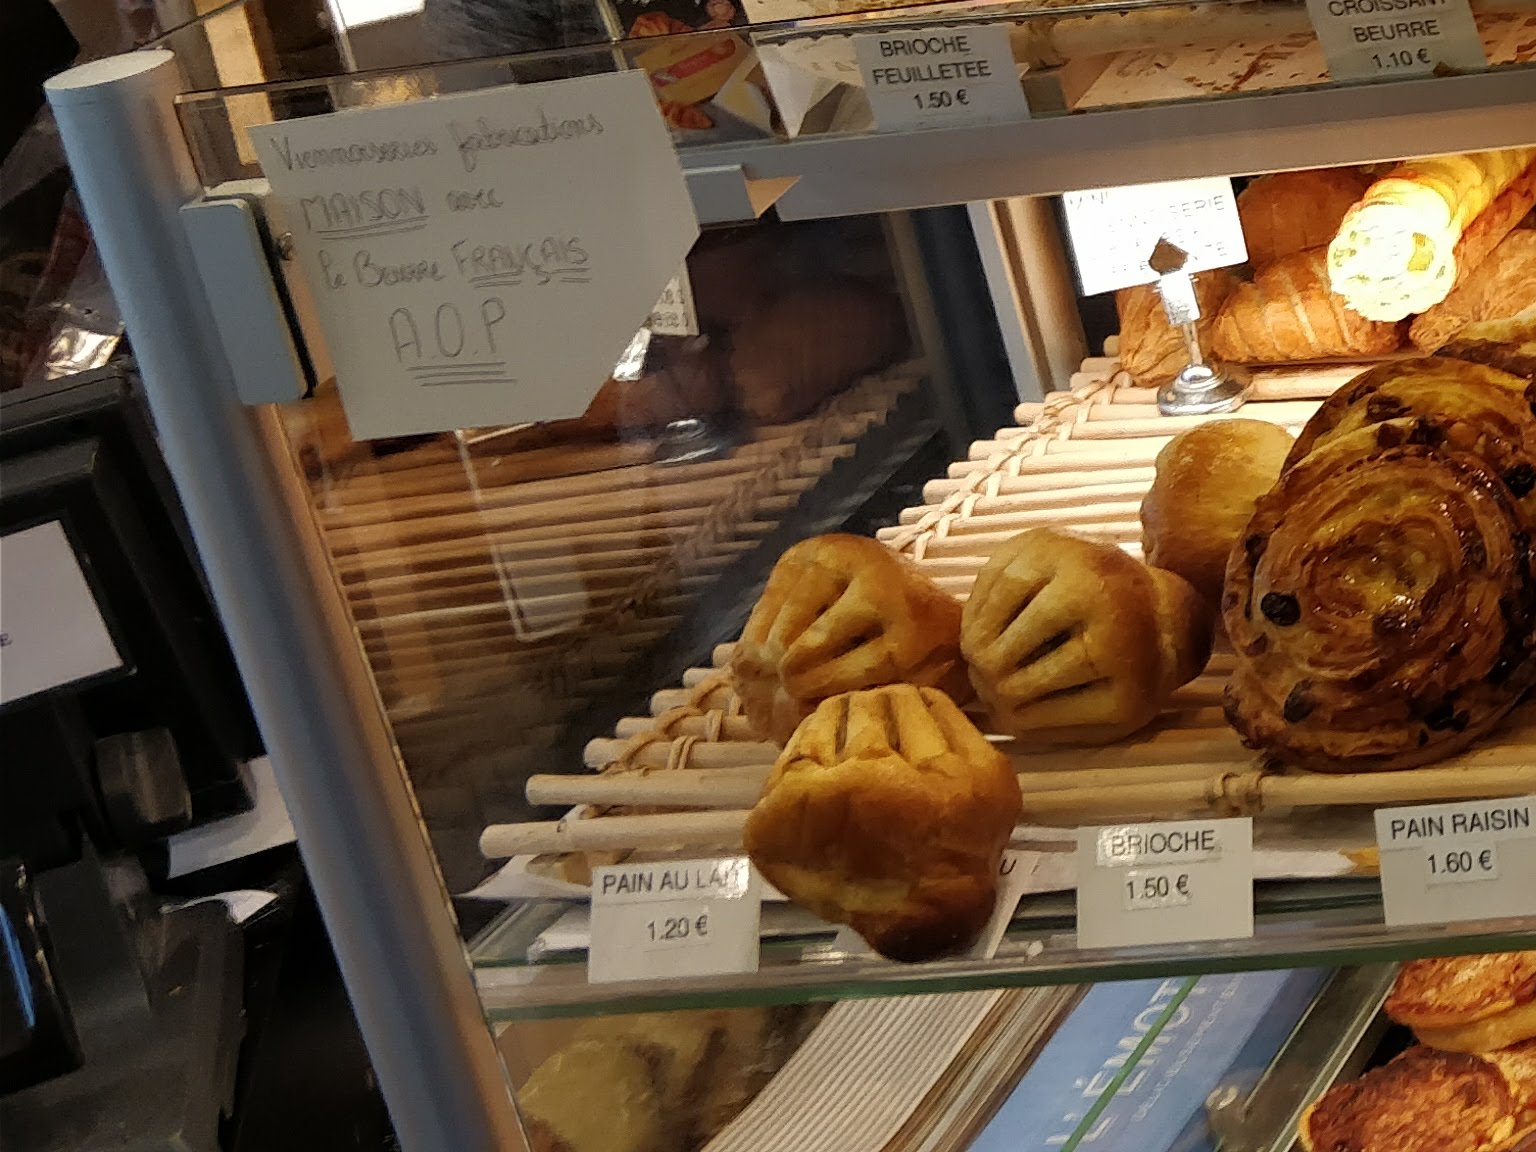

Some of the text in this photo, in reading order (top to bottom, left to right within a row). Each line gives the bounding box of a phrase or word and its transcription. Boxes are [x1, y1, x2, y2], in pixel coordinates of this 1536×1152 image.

[1352, 19, 1441, 43] BEURRE
[879, 35, 972, 58] BRIOCHE
[1371, 48, 1432, 71] 1.10 €
[872, 59, 992, 86] FEUILLETEE
[914, 89, 971, 110] 1.50 €
[301, 186, 427, 232] MAISON
[1391, 807, 1530, 840] PAIN RAISIN
[1110, 829, 1216, 857] BRIOCHE
[1427, 850, 1493, 875] 1.60 €
[602, 871, 654, 895] PAIN
[659, 869, 690, 892] AU
[1125, 873, 1190, 900] 1.50 €
[646, 914, 709, 942] 1.20 €
